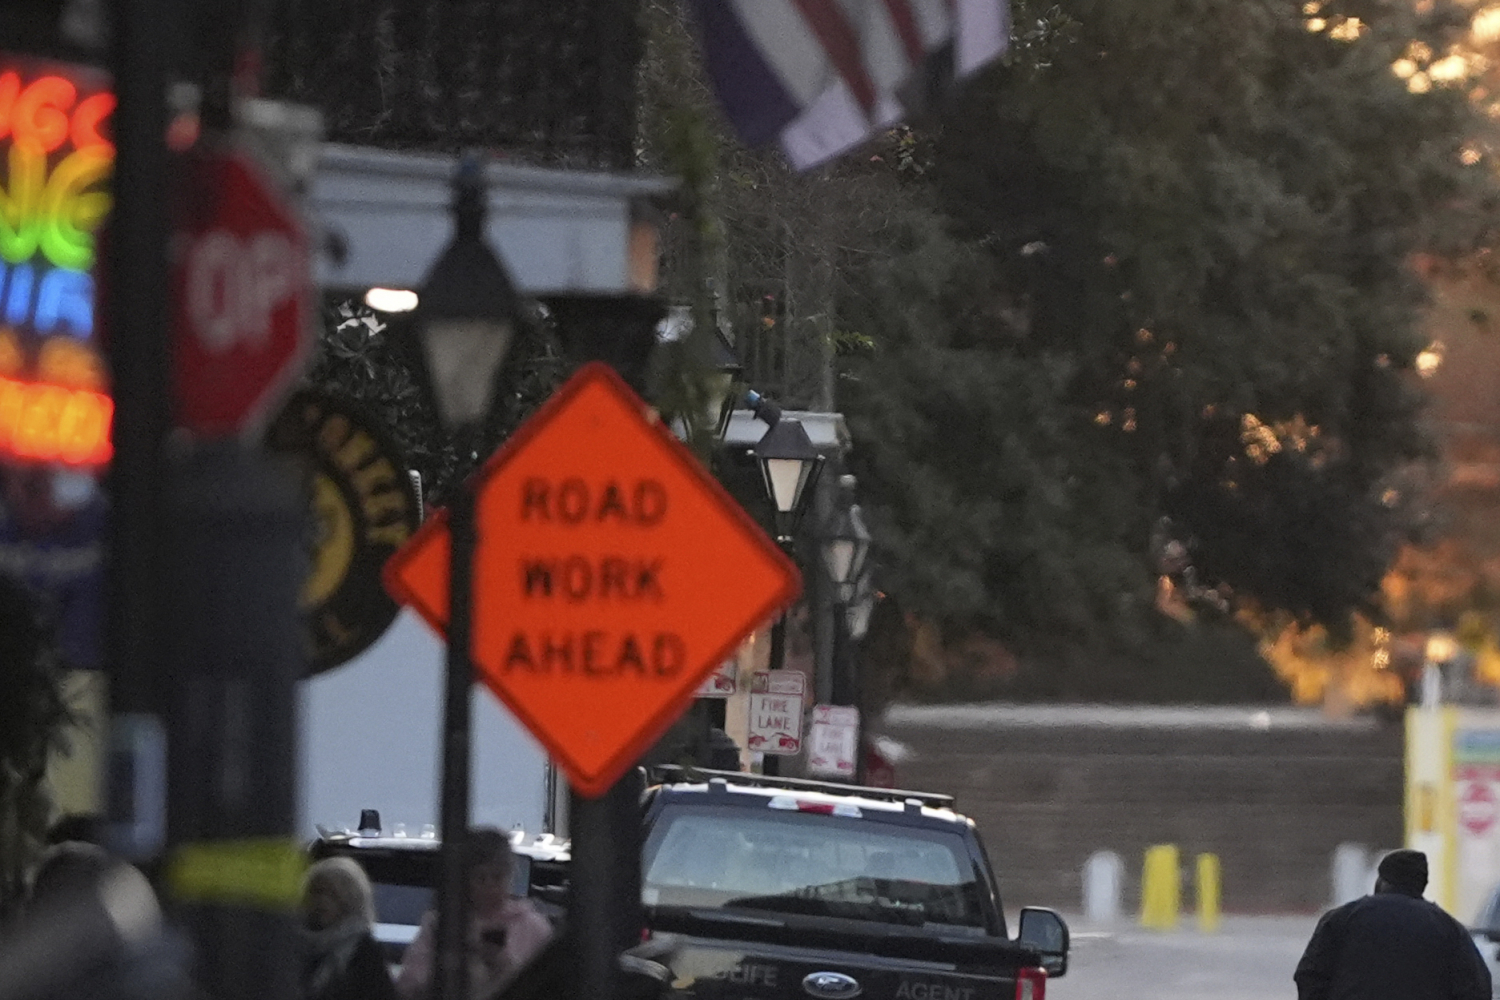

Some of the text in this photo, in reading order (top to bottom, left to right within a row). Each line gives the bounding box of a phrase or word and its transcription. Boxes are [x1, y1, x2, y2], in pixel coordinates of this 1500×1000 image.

[519, 476, 668, 527] ROAD
[518, 553, 667, 602] WORK
[503, 630, 690, 679] AHEAD
[758, 715, 791, 730] LANE
[762, 699, 787, 713] FIRE
